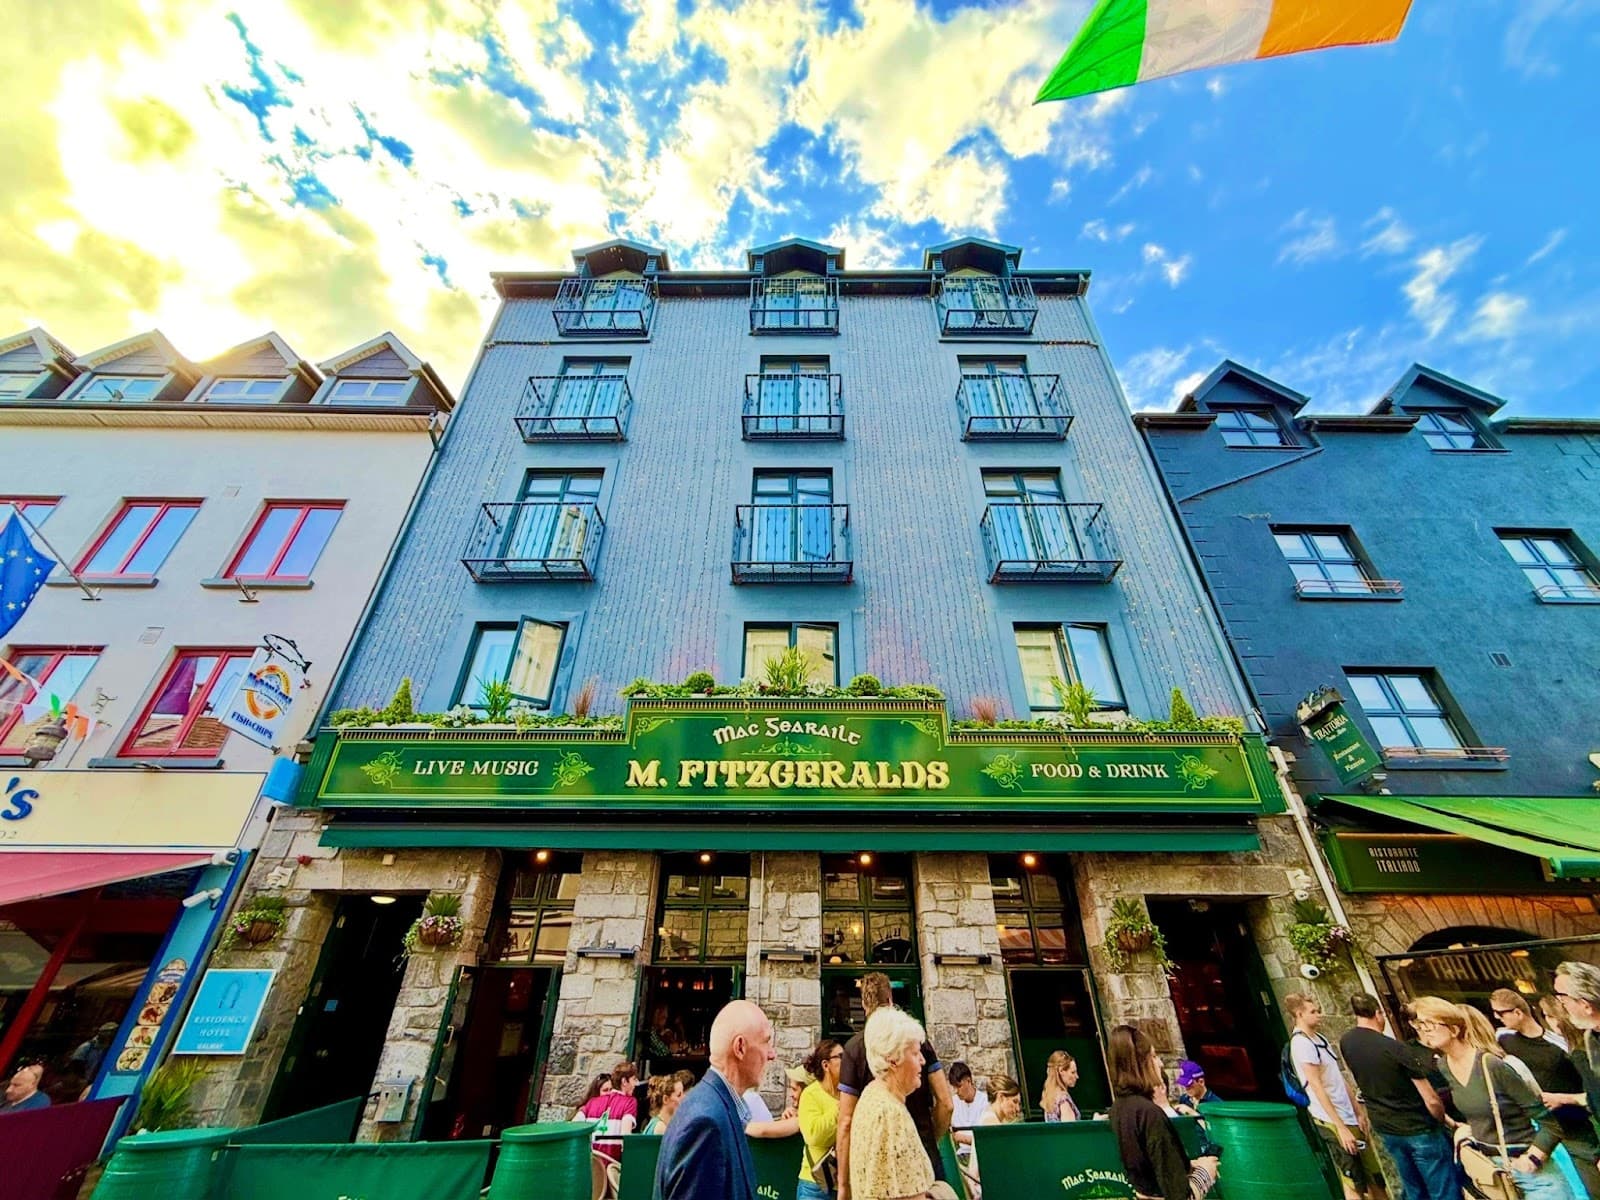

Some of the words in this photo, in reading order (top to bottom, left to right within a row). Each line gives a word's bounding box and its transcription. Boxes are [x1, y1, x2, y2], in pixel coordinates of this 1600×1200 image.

[1313, 714, 1349, 740] TRATTORIA
[413, 760, 465, 776] LIVE
[470, 760, 539, 776] MUSIC
[624, 759, 668, 789] M.
[679, 760, 950, 791] FITZGERALDS
[1030, 763, 1083, 778] FOOD
[1088, 764, 1102, 778] &
[1105, 763, 1169, 779] DRINK
[1375, 860, 1421, 873] ITALIANO
[194, 1015, 247, 1025] RESIDENCE
[200, 1028, 231, 1037] HOTEL
